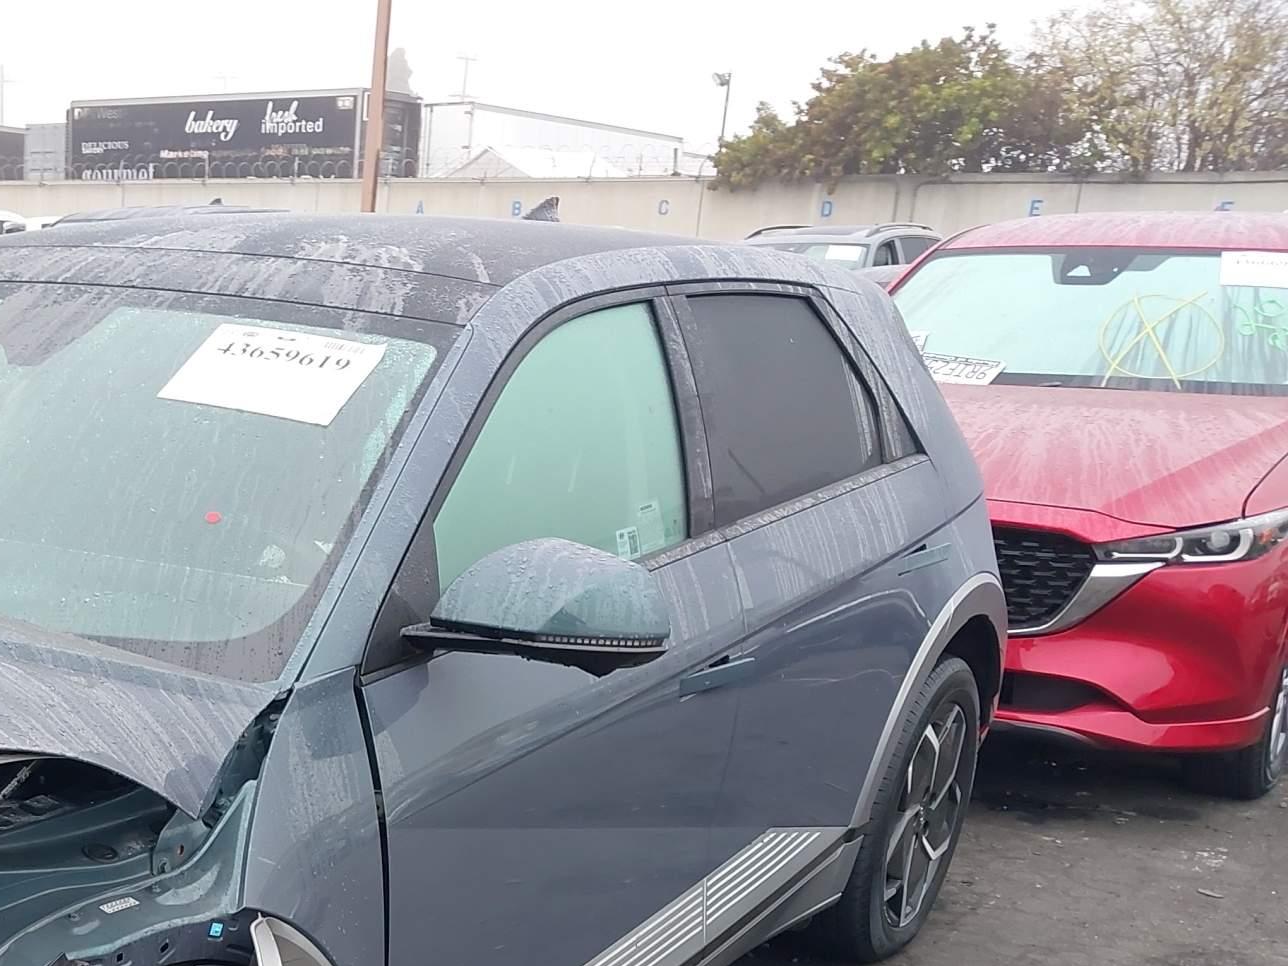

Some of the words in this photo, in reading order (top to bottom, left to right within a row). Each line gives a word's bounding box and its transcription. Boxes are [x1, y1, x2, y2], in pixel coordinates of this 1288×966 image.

[185, 110, 239, 141] bakery
[261, 118, 324, 136] imported
[415, 200, 425, 215] A
[512, 200, 522, 217] B
[657, 198, 670, 216] C
[819, 200, 834, 217] D
[1028, 199, 1044, 217] E
[217, 342, 352, 371] 43659619
